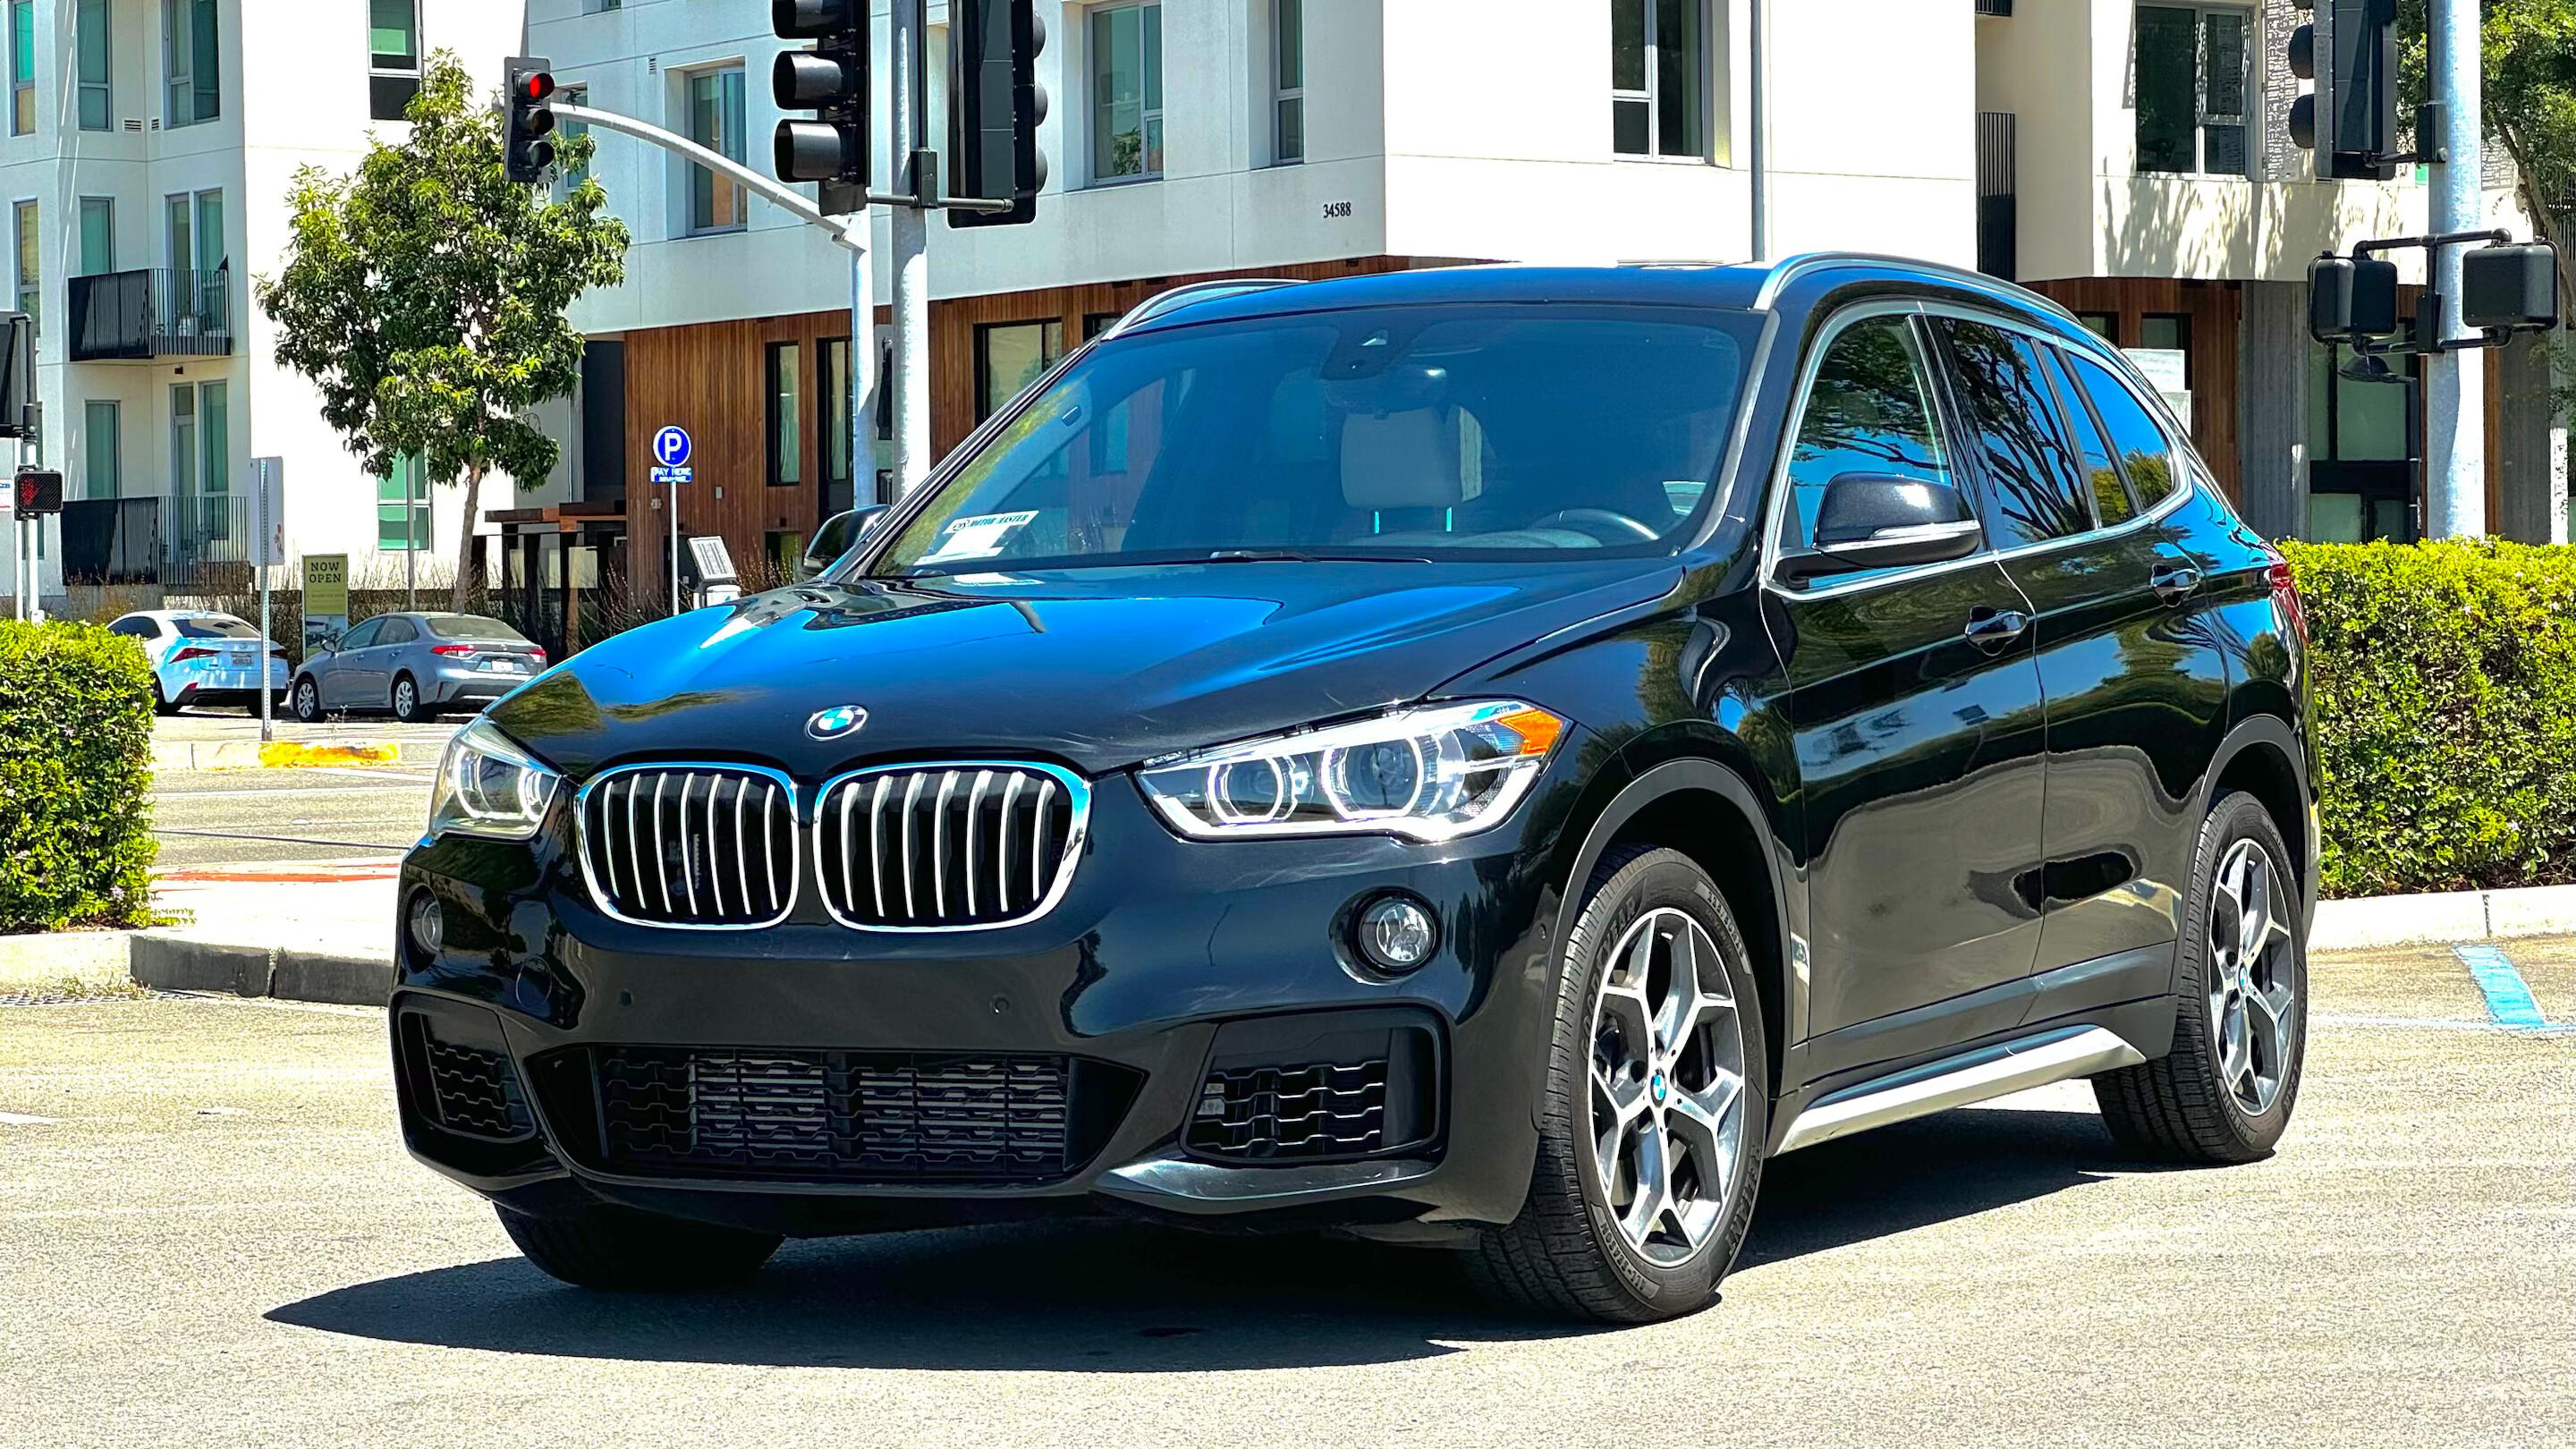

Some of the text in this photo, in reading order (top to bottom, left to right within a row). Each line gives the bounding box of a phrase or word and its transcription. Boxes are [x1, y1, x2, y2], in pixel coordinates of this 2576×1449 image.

[1323, 201, 1352, 218] 34588
[665, 433, 682, 461] P
[652, 467, 669, 476] PAY
[309, 572, 342, 583] OPEN
[310, 562, 340, 572] NOW
[1581, 896, 1635, 1060] GOODYEAR
[1725, 1142, 1762, 1257] RELIANT
[1600, 1222, 1647, 1292] ALL-SEASON
